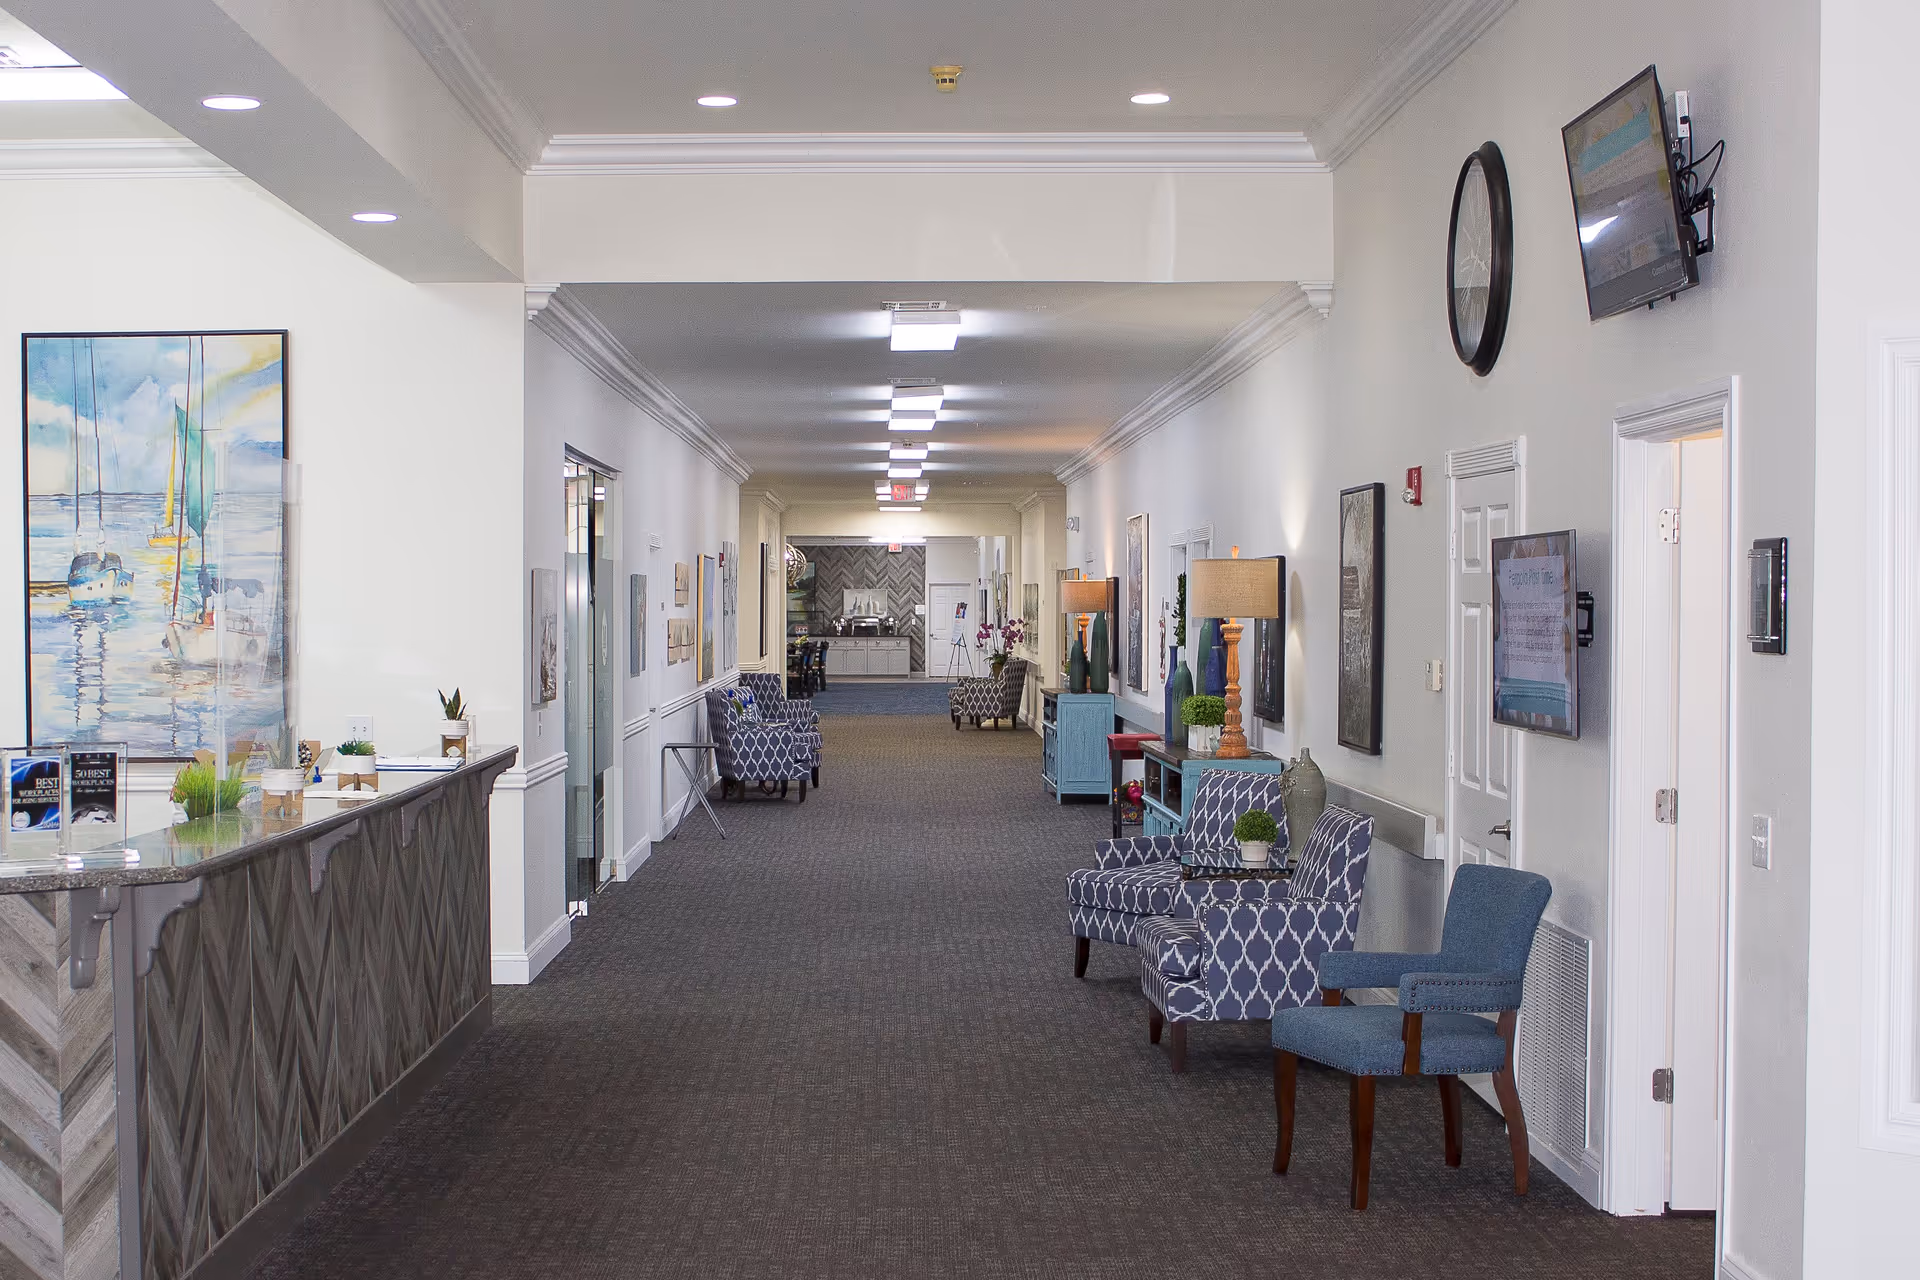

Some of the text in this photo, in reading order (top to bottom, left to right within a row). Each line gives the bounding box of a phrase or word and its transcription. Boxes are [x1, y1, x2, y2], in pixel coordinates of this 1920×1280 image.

[893, 485, 914, 500] EXIT
[75, 769, 111, 778] 50 BEST
[35, 777, 60, 789] BEST
[19, 789, 60, 797] WORKPLACES
